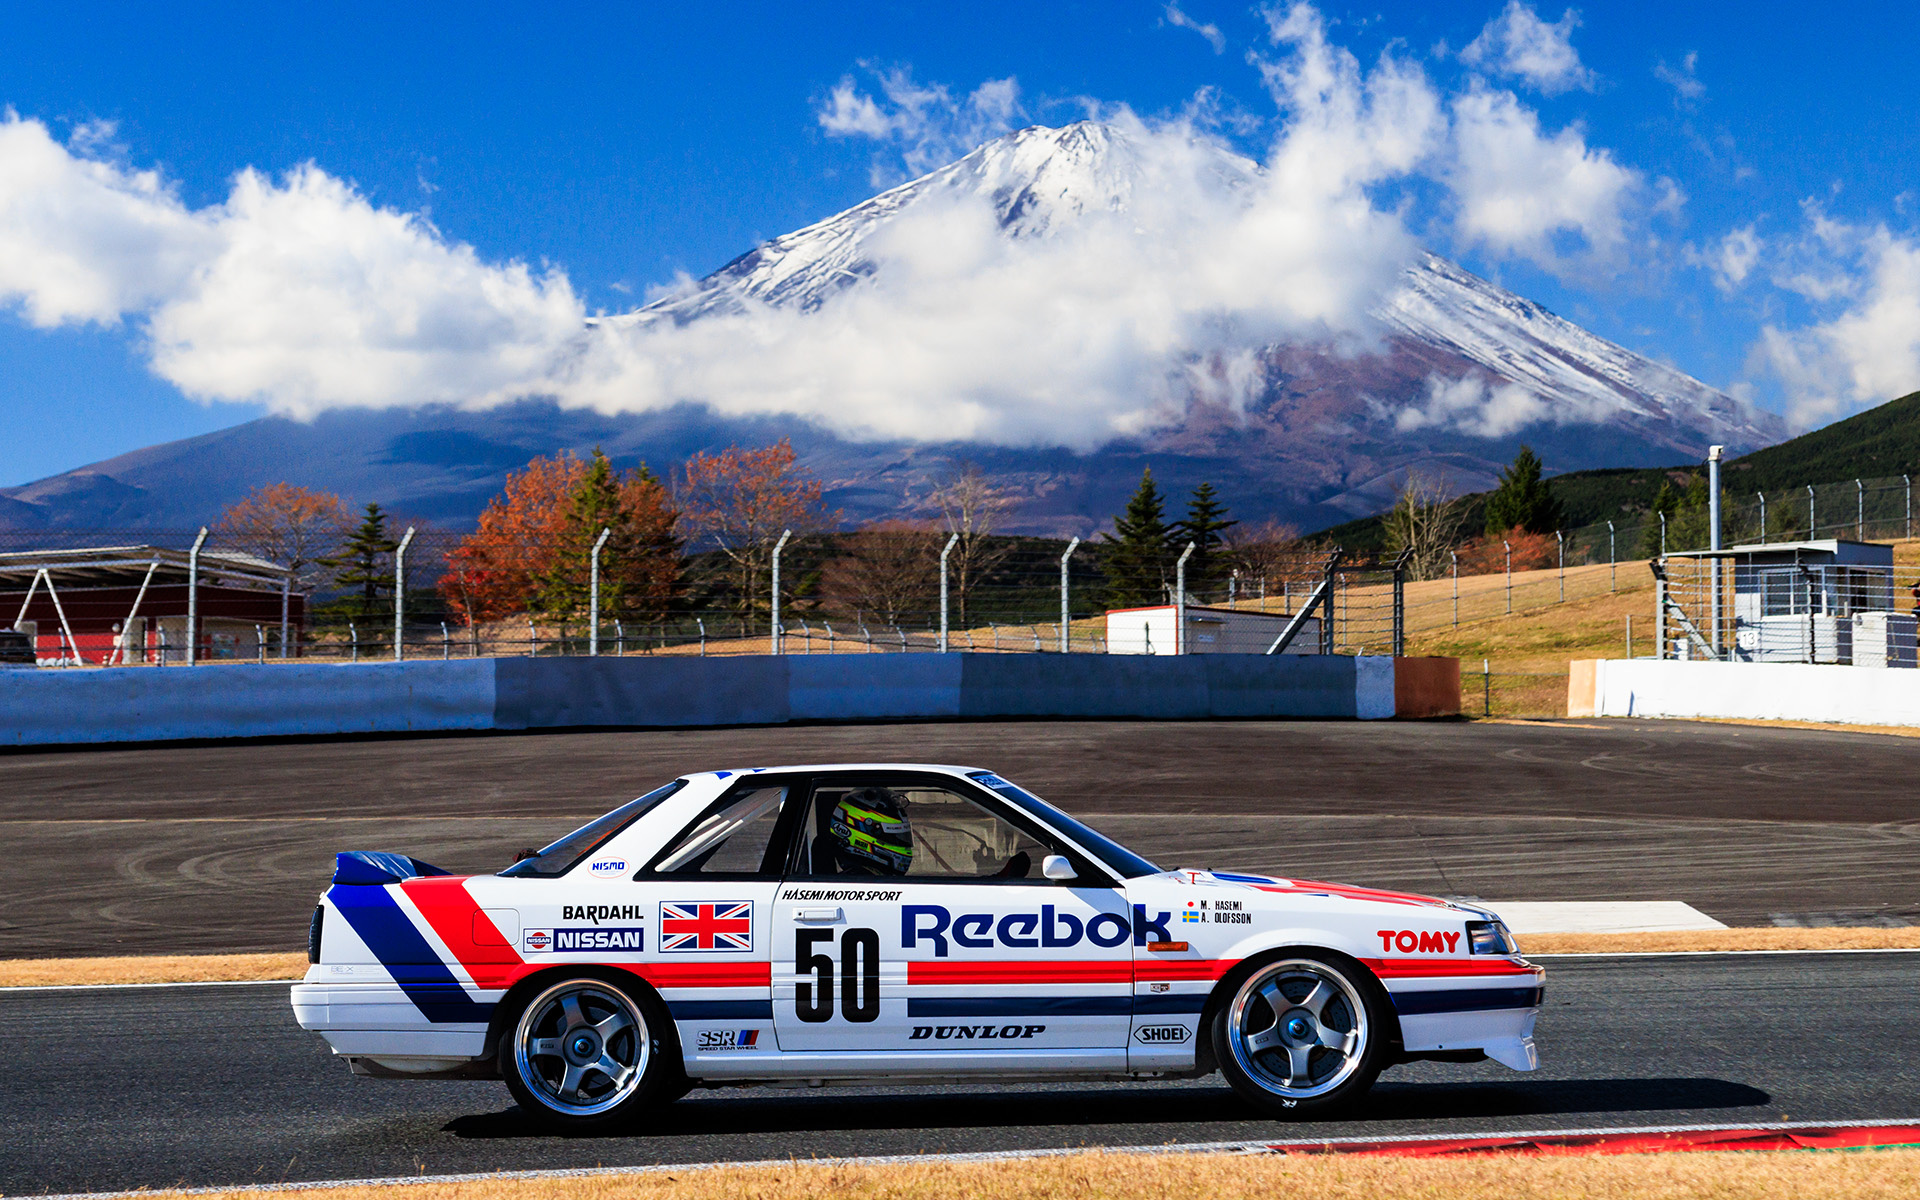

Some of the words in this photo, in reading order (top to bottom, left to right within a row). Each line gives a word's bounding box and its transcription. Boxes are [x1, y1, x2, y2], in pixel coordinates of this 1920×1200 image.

[1743, 632, 1755, 646] 13
[592, 861, 625, 871] NISMO
[824, 890, 865, 901] MOTOR
[864, 891, 903, 901] SPORT
[1200, 900, 1211, 911] M.
[1215, 900, 1243, 911] HASEMI
[562, 905, 644, 926] BARDAHL
[1201, 912, 1210, 924] A.
[1214, 912, 1252, 925] OLOFSSON
[901, 903, 1172, 957] Reebok
[558, 931, 640, 949] NISSAN
[1377, 930, 1461, 954] TOMY
[795, 927, 880, 1023] 50
[696, 1029, 736, 1047] SSR
[908, 1024, 1047, 1040] DUNLOP
[1142, 1027, 1184, 1041] SHOEI
